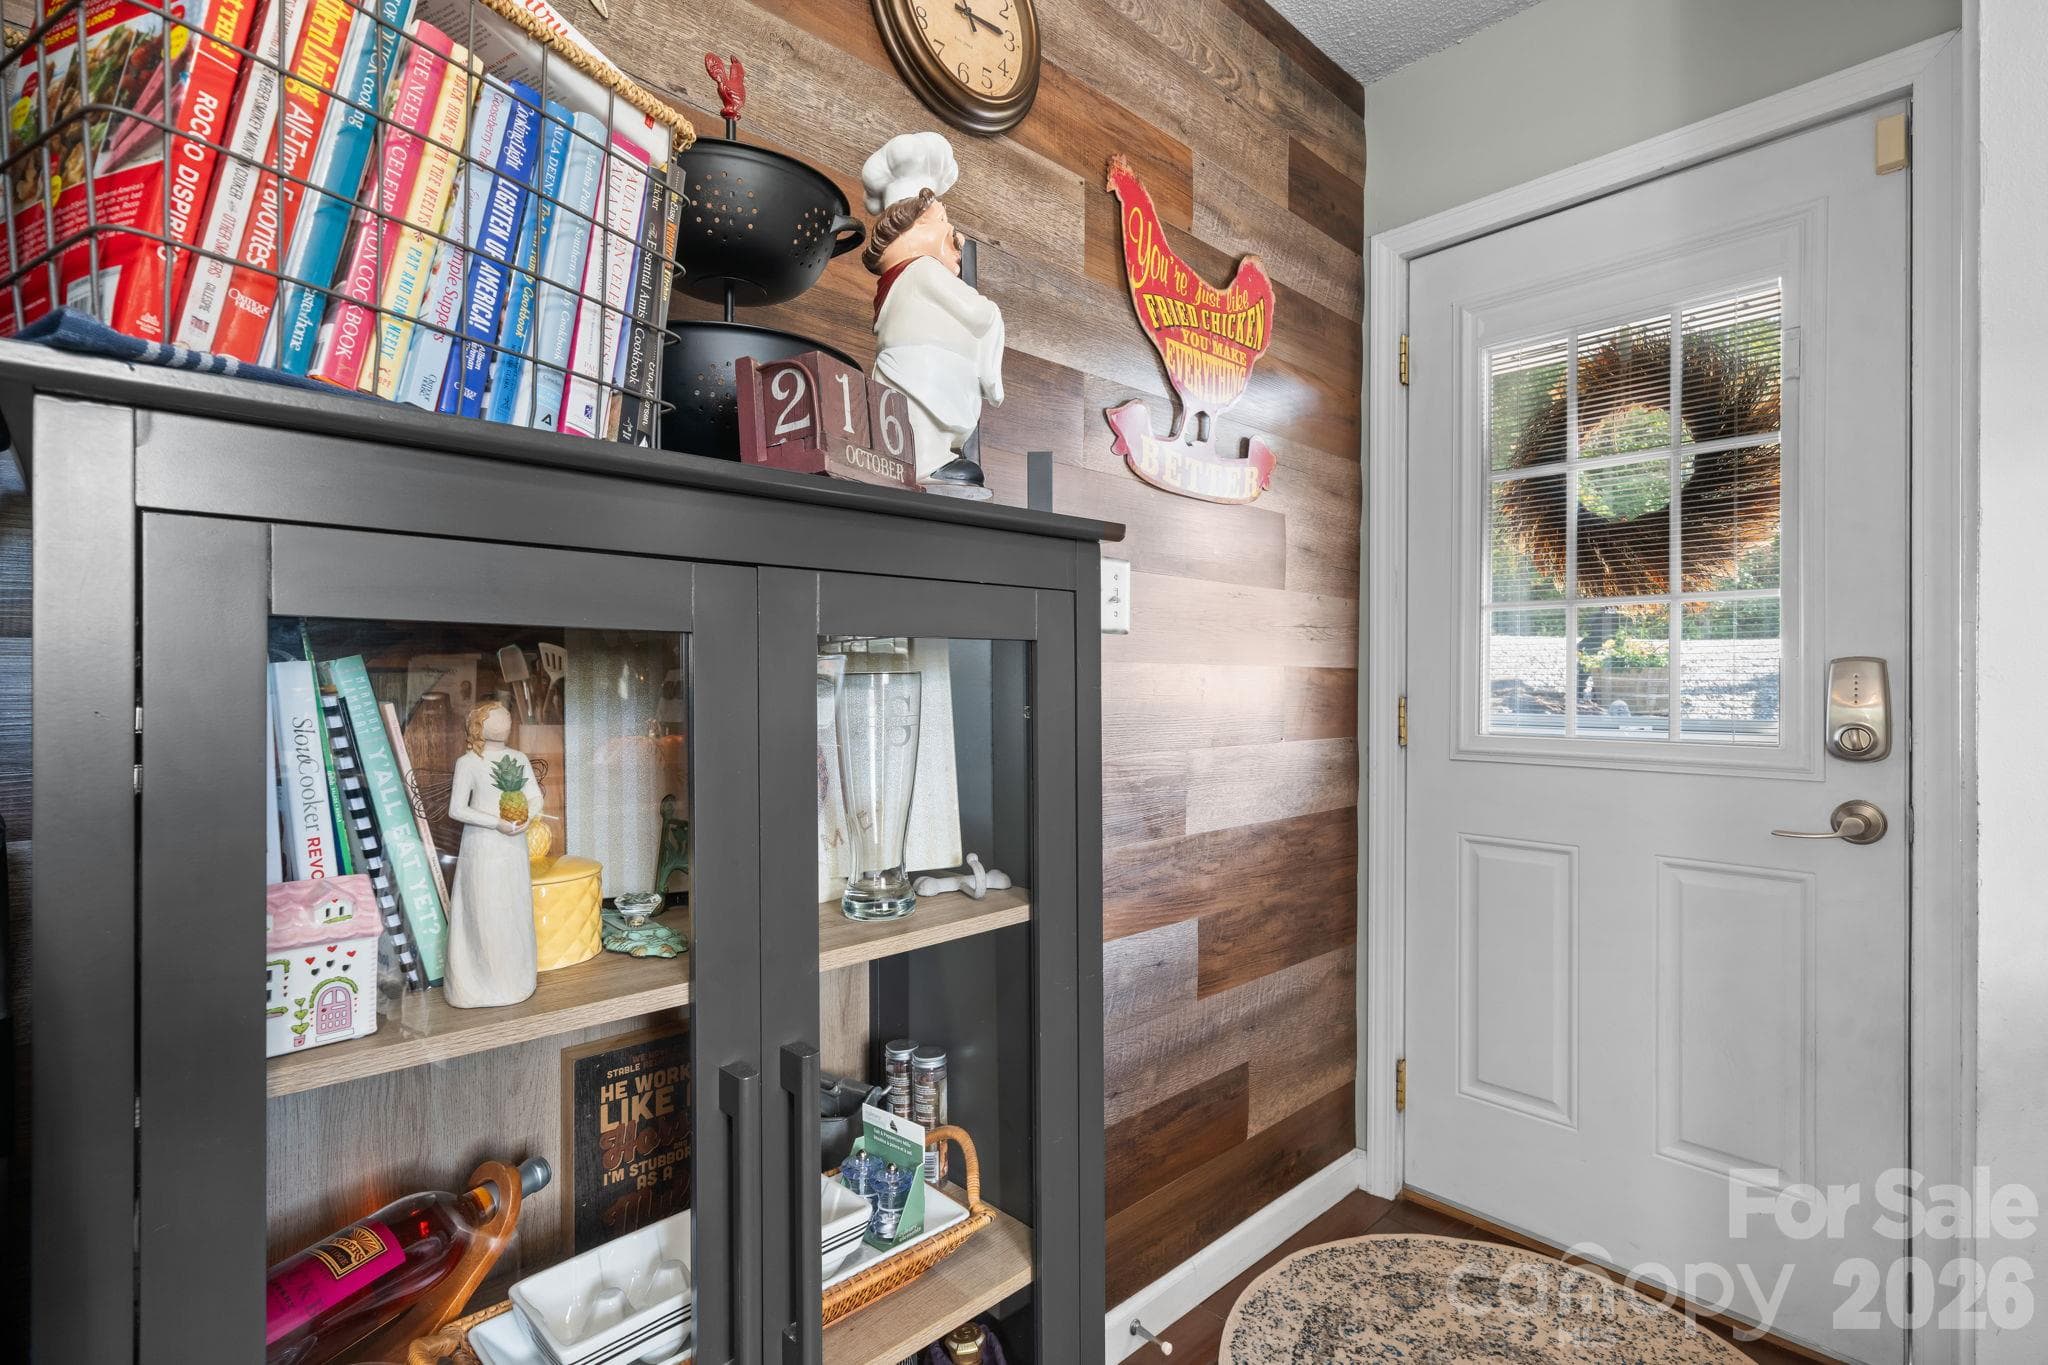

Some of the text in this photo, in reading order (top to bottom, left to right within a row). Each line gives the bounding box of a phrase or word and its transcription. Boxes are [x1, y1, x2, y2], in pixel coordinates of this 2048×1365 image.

[380, 2, 398, 22] OF
[915, 5, 929, 30] 8
[411, 45, 435, 78] THE
[1004, 29, 1016, 52] 3
[281, 38, 340, 109] Living
[957, 62, 970, 84] 6
[981, 66, 994, 90] 5
[997, 57, 1009, 77] 4
[181, 89, 220, 160] ROCCO
[346, 75, 377, 129] cookng
[478, 91, 507, 145] Gooseberry
[228, 72, 275, 200] WEBER SMOKEY MOUNTN COOKER
[414, 73, 469, 226] BACK HOME WTH THE NEELYS
[472, 143, 493, 173] Path
[154, 162, 201, 264] DISPIRIO
[359, 144, 408, 270] CELEBRTION
[574, 188, 592, 226] Pulle's
[620, 166, 640, 213] PAULA
[650, 182, 664, 211] Eicher
[666, 201, 679, 222] Easy
[217, 212, 237, 241] OTHER
[243, 176, 296, 271] Favorites
[662, 221, 677, 269] Vegetarin
[403, 245, 423, 270] PAT
[441, 242, 469, 286] imple
[465, 177, 521, 331] LIGHTEN UP AMERICA!
[519, 247, 542, 286] Famly
[565, 226, 586, 274] Southern
[639, 239, 657, 289] Esential
[1128, 206, 1250, 313] You're just like
[198, 281, 218, 313] GILLESPIE
[396, 270, 416, 295] AND
[333, 266, 375, 360] COOKBOOK
[427, 286, 460, 344] Suppers
[513, 286, 535, 338] Cookbook
[550, 309, 573, 362] Cookbook
[1142, 292, 1266, 353] FRIED CHICKEN
[378, 322, 403, 361] NEELY
[627, 328, 646, 384] Cookbook
[1181, 327, 1248, 365] YOU MAKE
[1165, 337, 1248, 402] EVERYTHING
[640, 381, 655, 426] Alerson
[771, 368, 904, 455] 2 1 6
[845, 444, 905, 483] OCTOBER
[1139, 433, 1260, 498] BETTER
[341, 678, 370, 735] LAMBERT
[355, 675, 382, 734] MIRANDA
[367, 747, 403, 818] Y'ALL
[391, 821, 422, 872] EAT
[408, 876, 441, 935] YET?
[600, 1080, 628, 1104] HE
[606, 1062, 641, 1079] STABLE
[600, 1086, 675, 1133] LIKE
[603, 1168, 625, 1187] I'M
[636, 1165, 673, 1190] AS A
